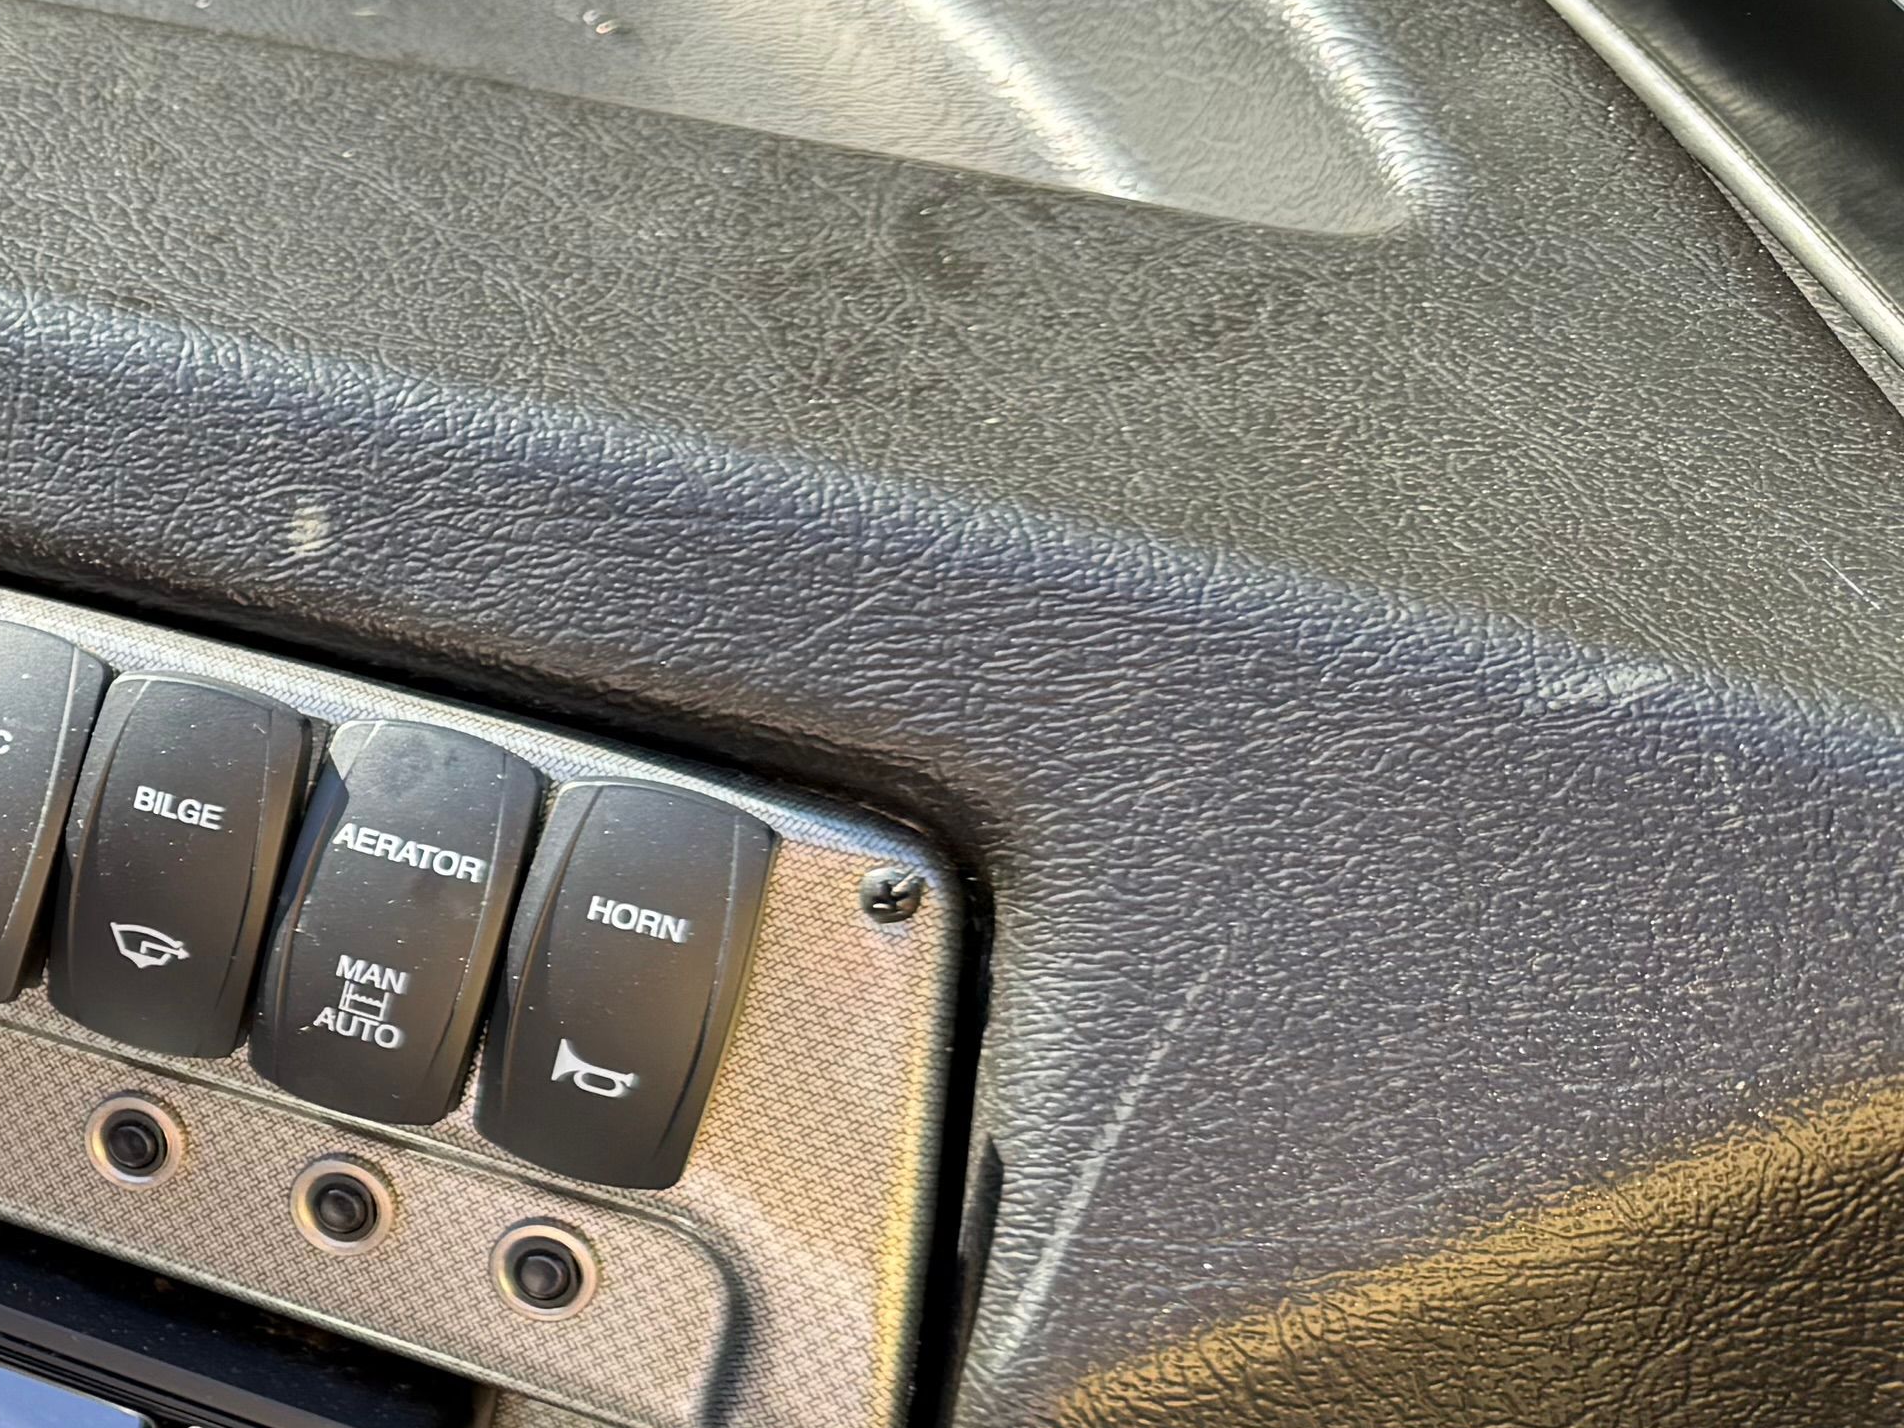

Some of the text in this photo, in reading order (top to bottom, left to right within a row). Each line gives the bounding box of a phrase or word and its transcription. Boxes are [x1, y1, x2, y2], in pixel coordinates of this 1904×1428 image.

[133, 785, 227, 831] BILGE
[333, 823, 487, 883] AERATOR
[586, 894, 689, 944] HORN
[335, 954, 409, 995] MAN
[312, 1006, 405, 1051] AUTO
